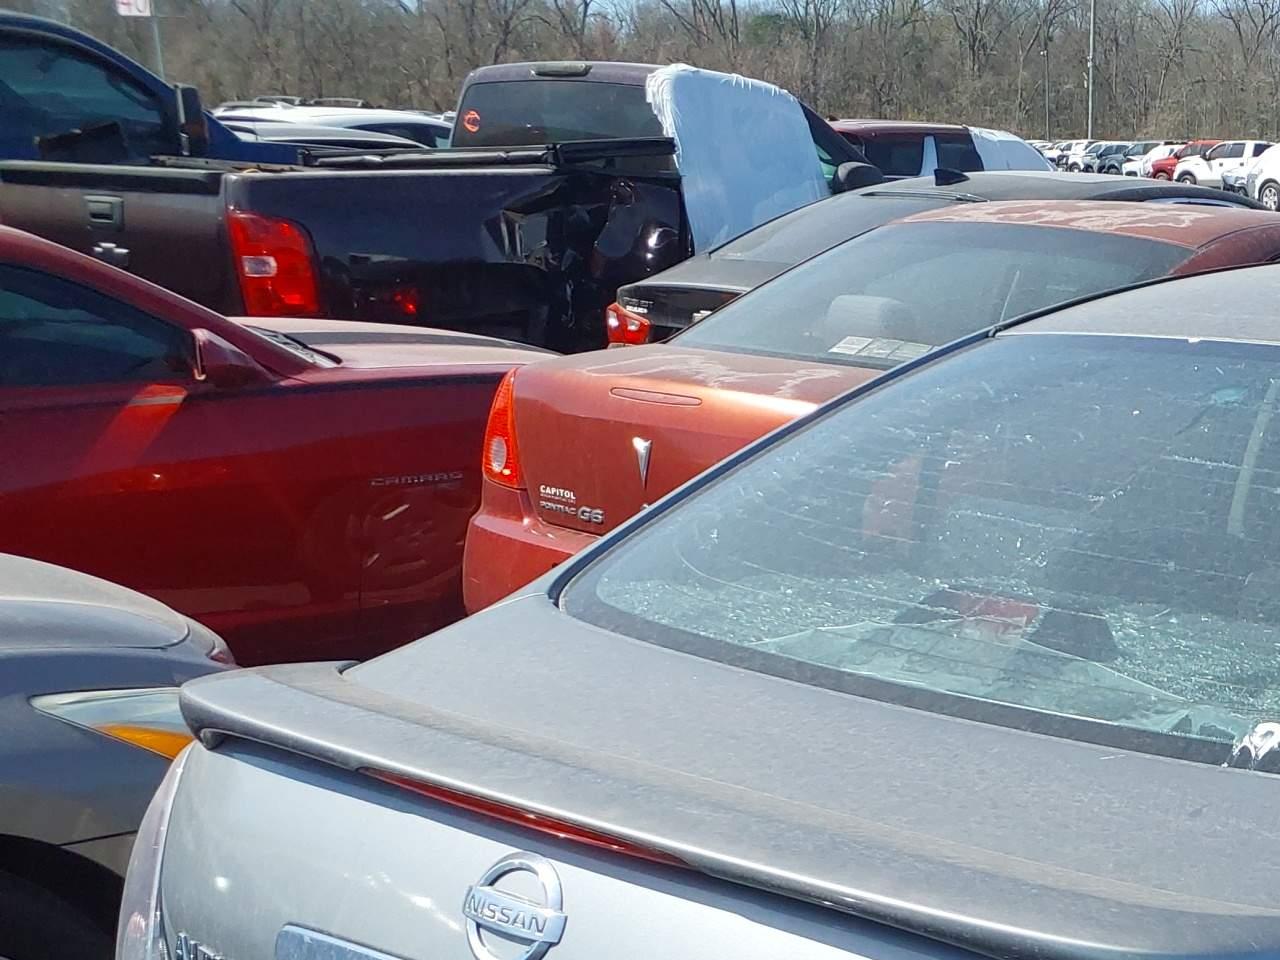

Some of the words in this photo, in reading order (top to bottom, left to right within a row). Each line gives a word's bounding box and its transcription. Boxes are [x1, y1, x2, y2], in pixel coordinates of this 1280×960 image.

[540, 484, 577, 500] CAPITOL
[577, 505, 605, 524] G6
[467, 893, 548, 935] NISSAN
